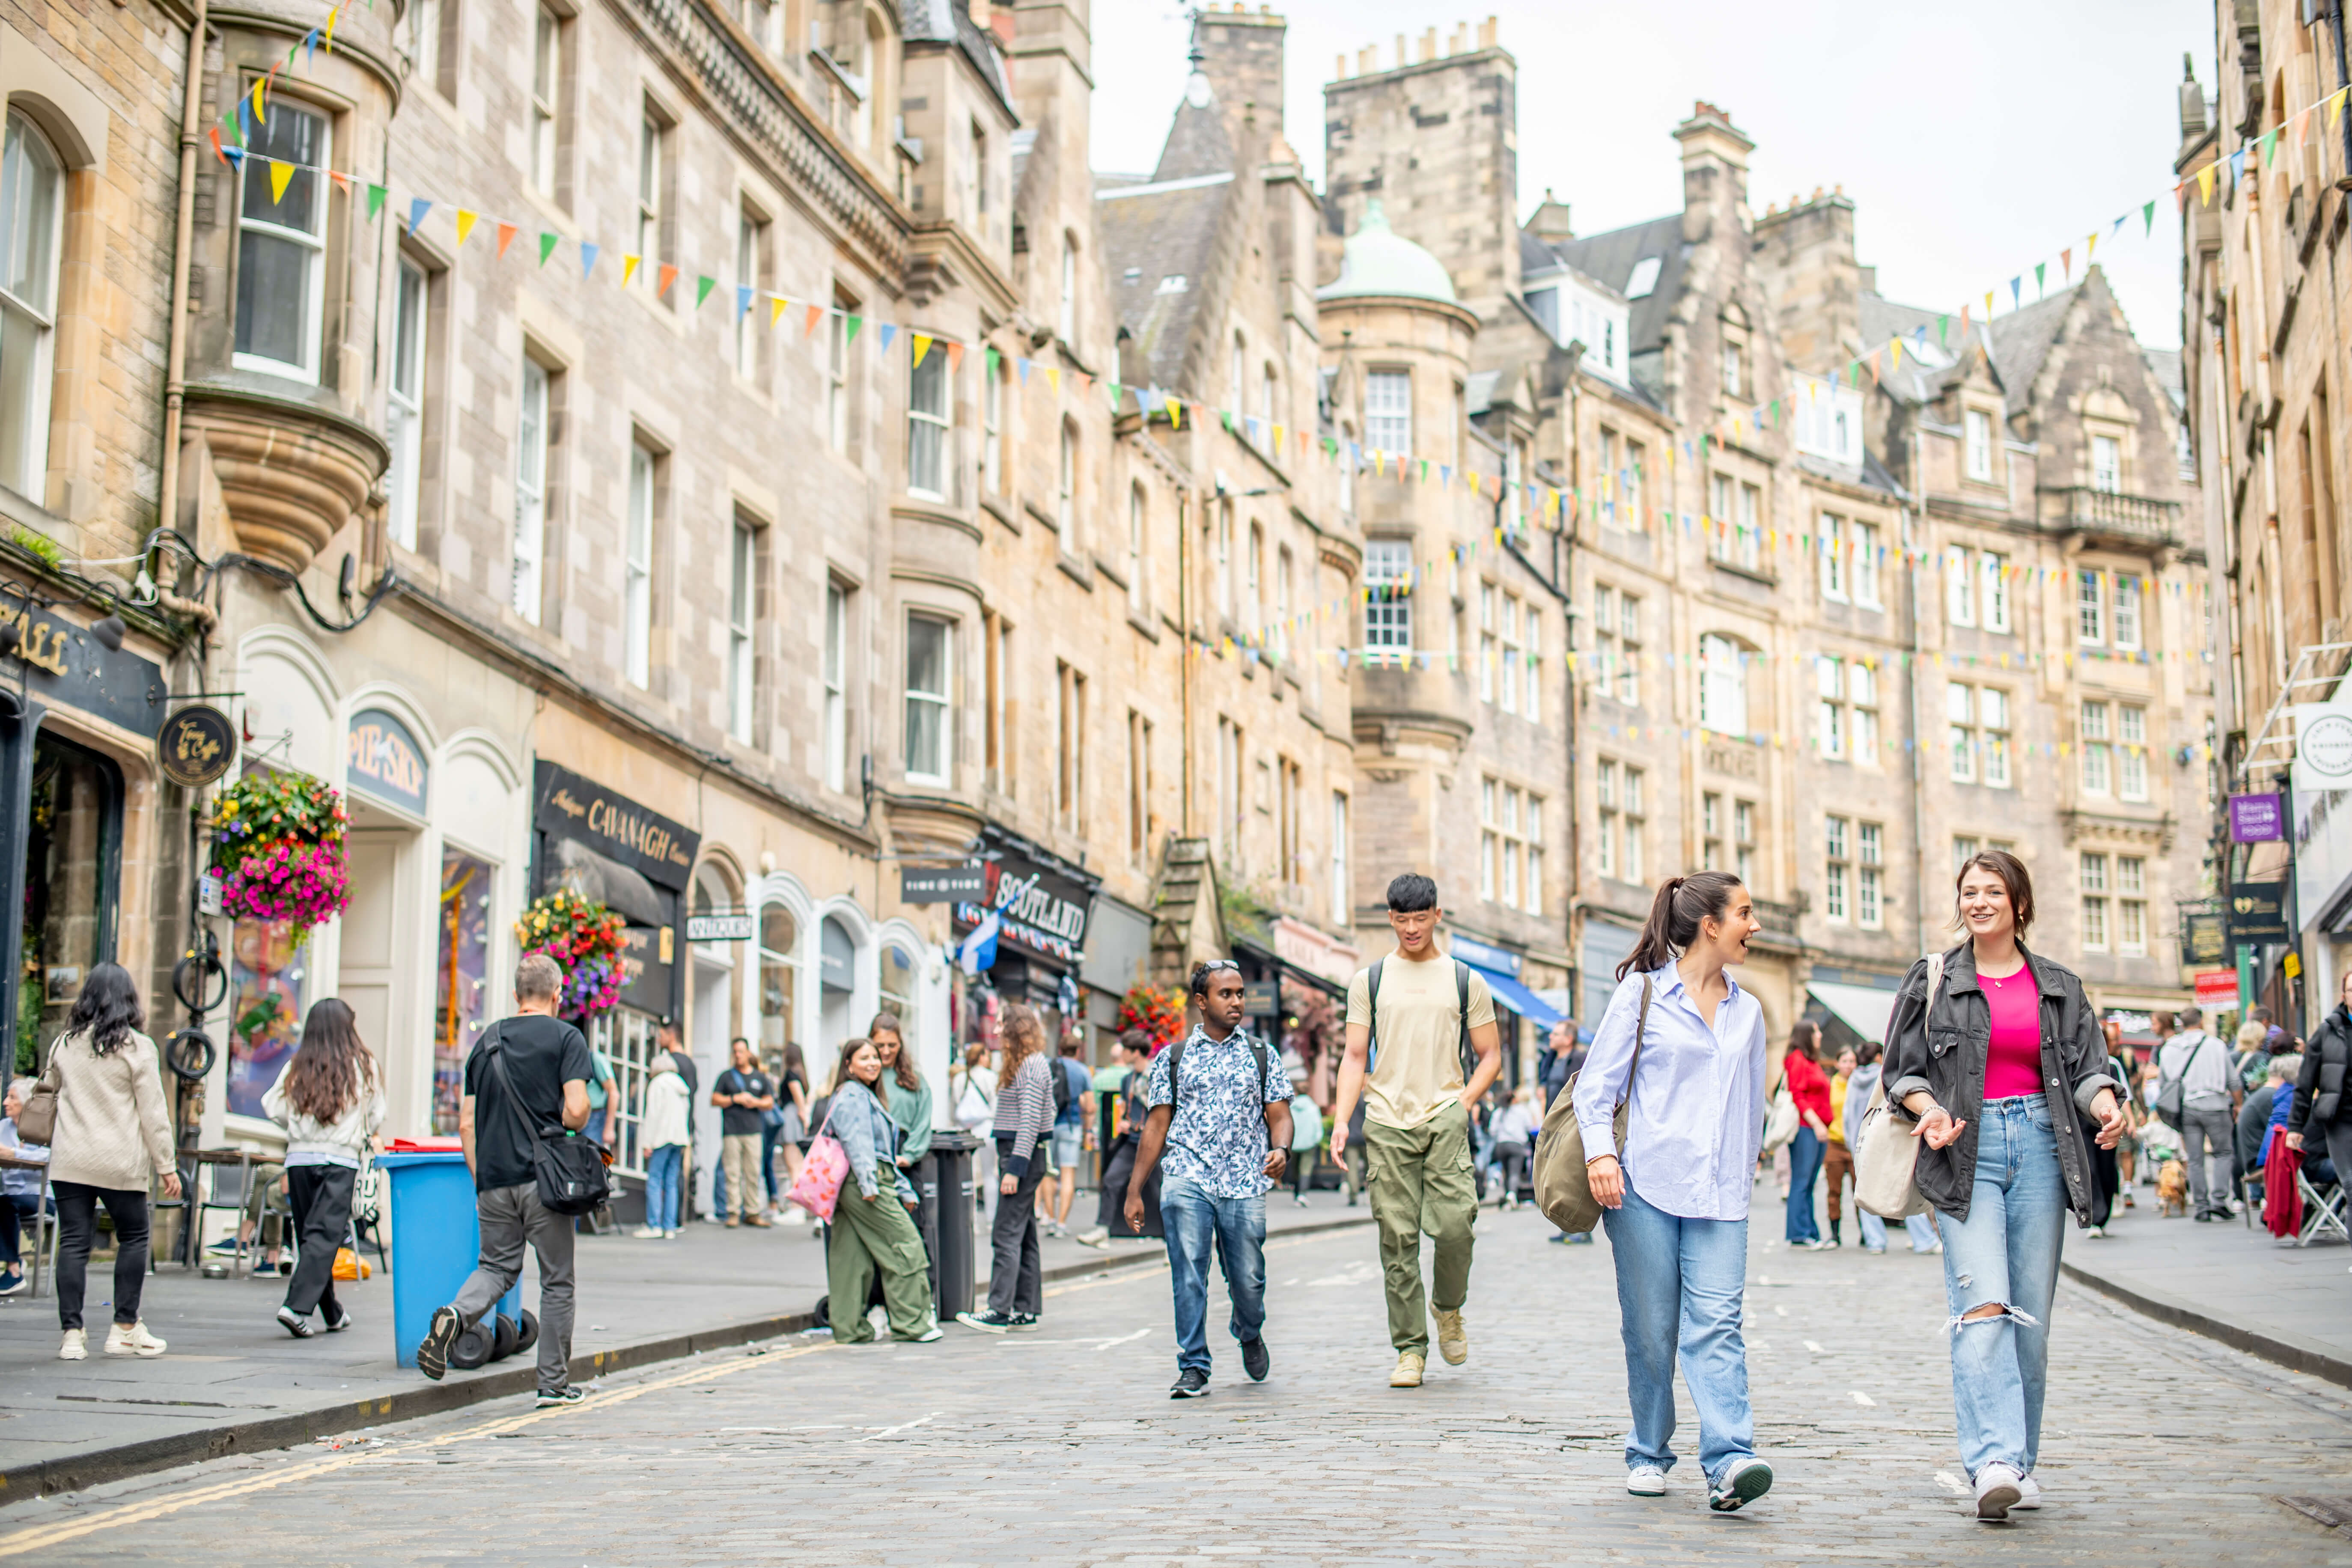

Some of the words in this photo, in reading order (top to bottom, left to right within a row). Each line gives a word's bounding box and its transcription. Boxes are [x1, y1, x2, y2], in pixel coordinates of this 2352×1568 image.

[587, 798, 671, 862] CAVANAGH
[690, 918, 750, 937] ANTIQUES
[995, 871, 1085, 942] SCOTLAND
